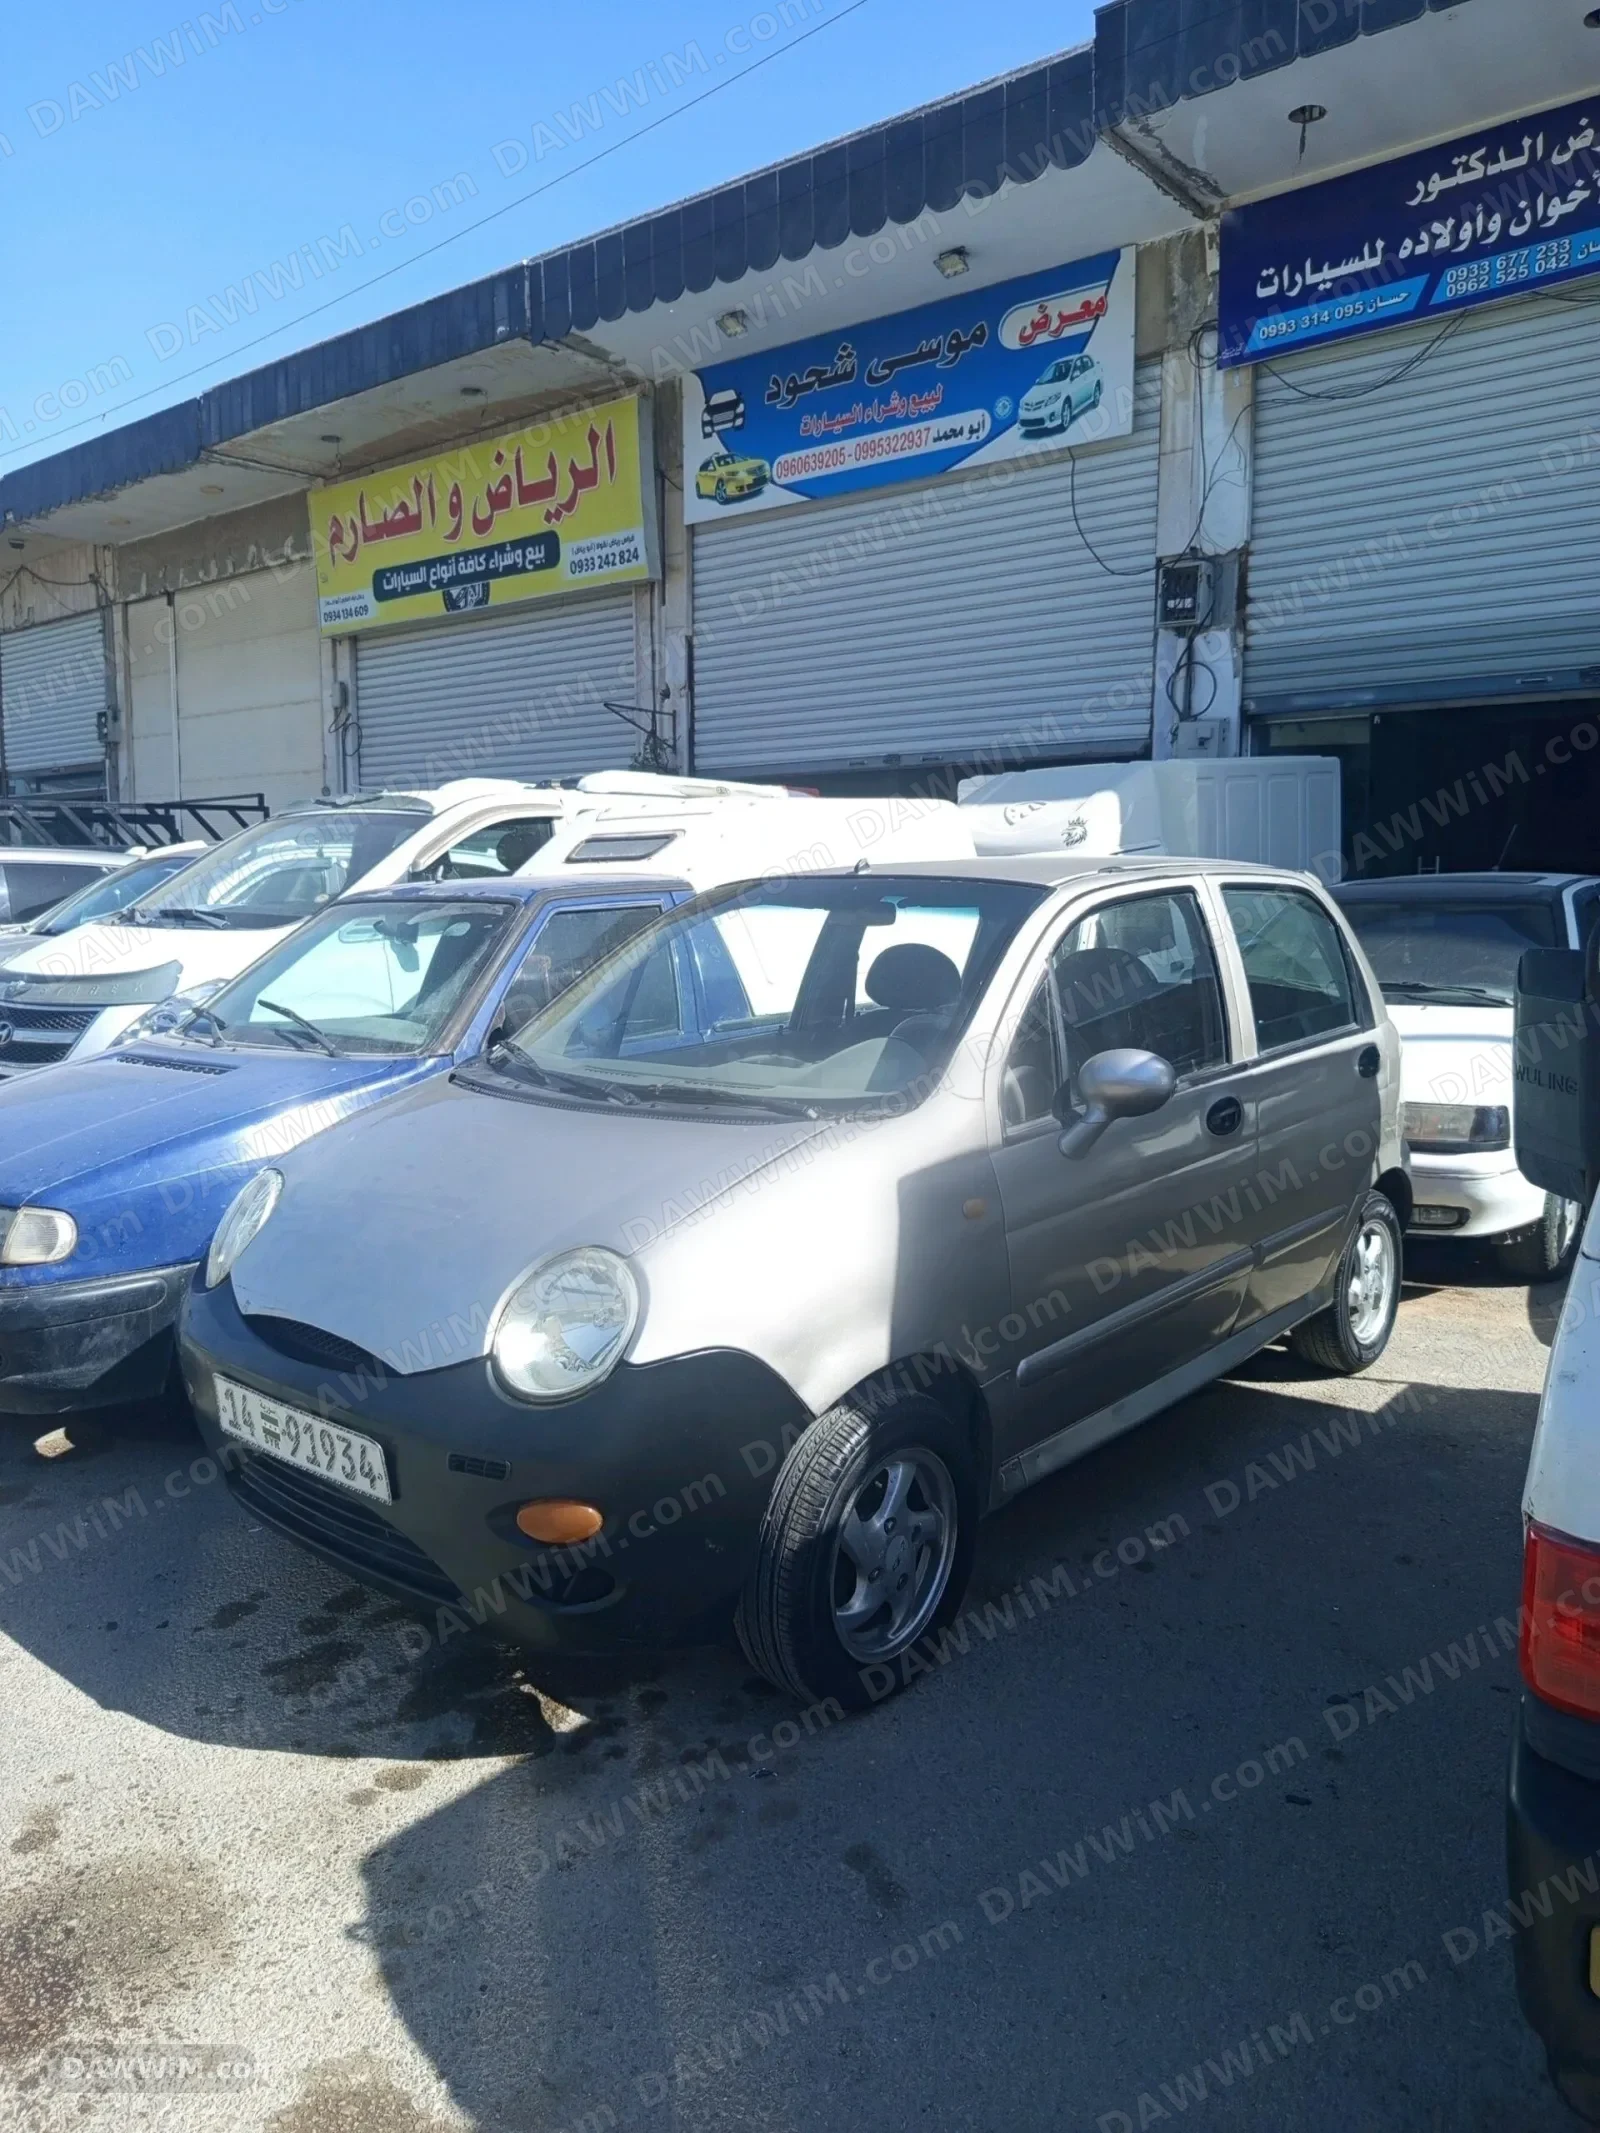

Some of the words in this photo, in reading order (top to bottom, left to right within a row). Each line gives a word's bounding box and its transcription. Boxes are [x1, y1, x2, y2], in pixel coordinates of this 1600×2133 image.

[1406, 132, 1544, 206] الدكتور
[1398, 202, 1503, 259] وأولاده
[1256, 238, 1386, 300] للسيارات
[1446, 275, 1489, 297] 0962
[1496, 264, 1529, 284] 525
[1535, 254, 1570, 274] 042
[1447, 261, 1490, 284] 0933
[1496, 249, 1530, 270] 677
[1536, 239, 1571, 259] 233
[1335, 301, 1364, 320] 095
[1367, 292, 1409, 314] حسان
[1018, 294, 1108, 346] معرض
[1259, 320, 1297, 341] 0993
[1300, 310, 1331, 329] 314
[864, 320, 989, 387] موسى
[764, 342, 858, 409] شحود
[864, 390, 906, 423] وشراء
[908, 383, 943, 416] لبيع
[800, 403, 863, 438] السيارات
[932, 426, 964, 444] محمد
[966, 413, 985, 441] أبو
[472, 418, 616, 537] الرياض
[329, 472, 436, 568] الصارم
[443, 482, 464, 543] و
[457, 553, 486, 575] كافة
[489, 543, 523, 572] وشراء
[525, 544, 546, 570] بيع
[570, 556, 596, 575] 0933
[597, 552, 617, 570] 242
[618, 547, 639, 565] 824
[382, 567, 426, 592] السيارات
[430, 558, 457, 589] أنواع
[323, 609, 341, 622] 0934
[341, 607, 353, 619] 134
[354, 604, 369, 617] 609
[1516, 1065, 1578, 1096] WULING
[224, 1387, 256, 1437] 14
[284, 1414, 377, 1490] 91934
[263, 1433, 281, 1450] SYR
